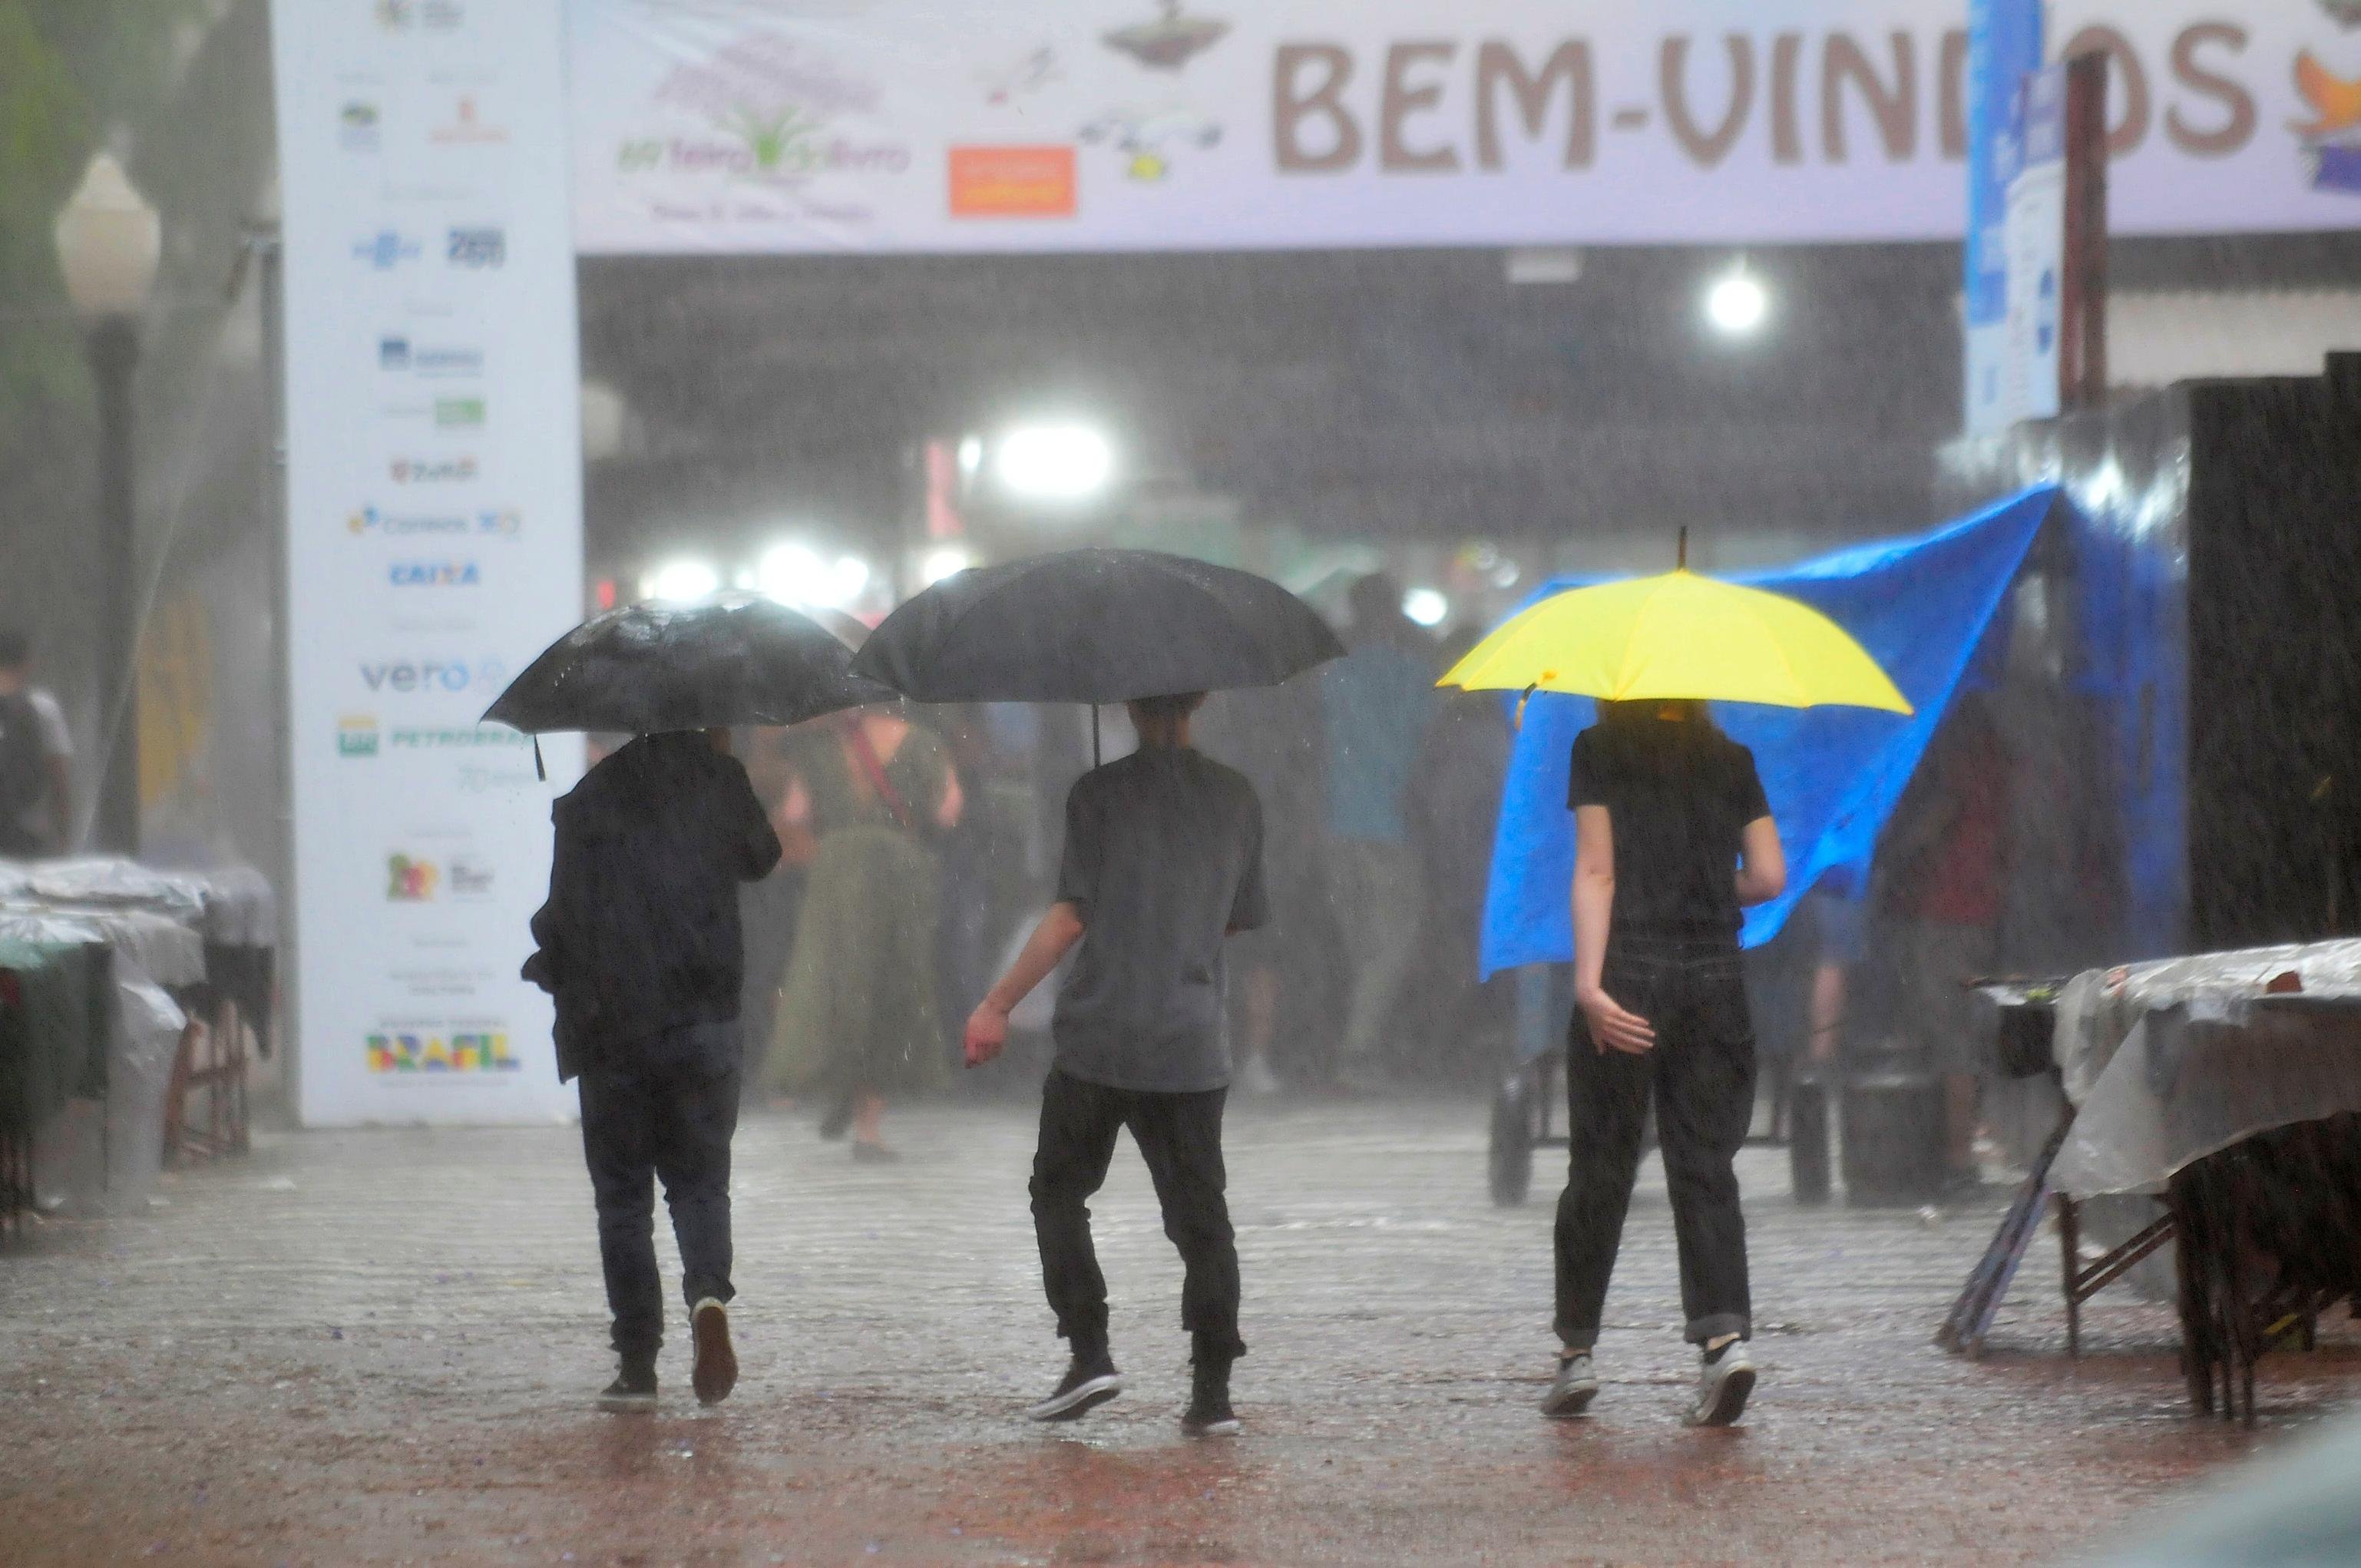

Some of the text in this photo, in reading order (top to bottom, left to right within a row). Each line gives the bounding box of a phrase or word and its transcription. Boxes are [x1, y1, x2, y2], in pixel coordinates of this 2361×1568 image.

[389, 564, 479, 586] CAIXA
[359, 660, 471, 693] vero
[365, 1033, 522, 1073] BRASIL
